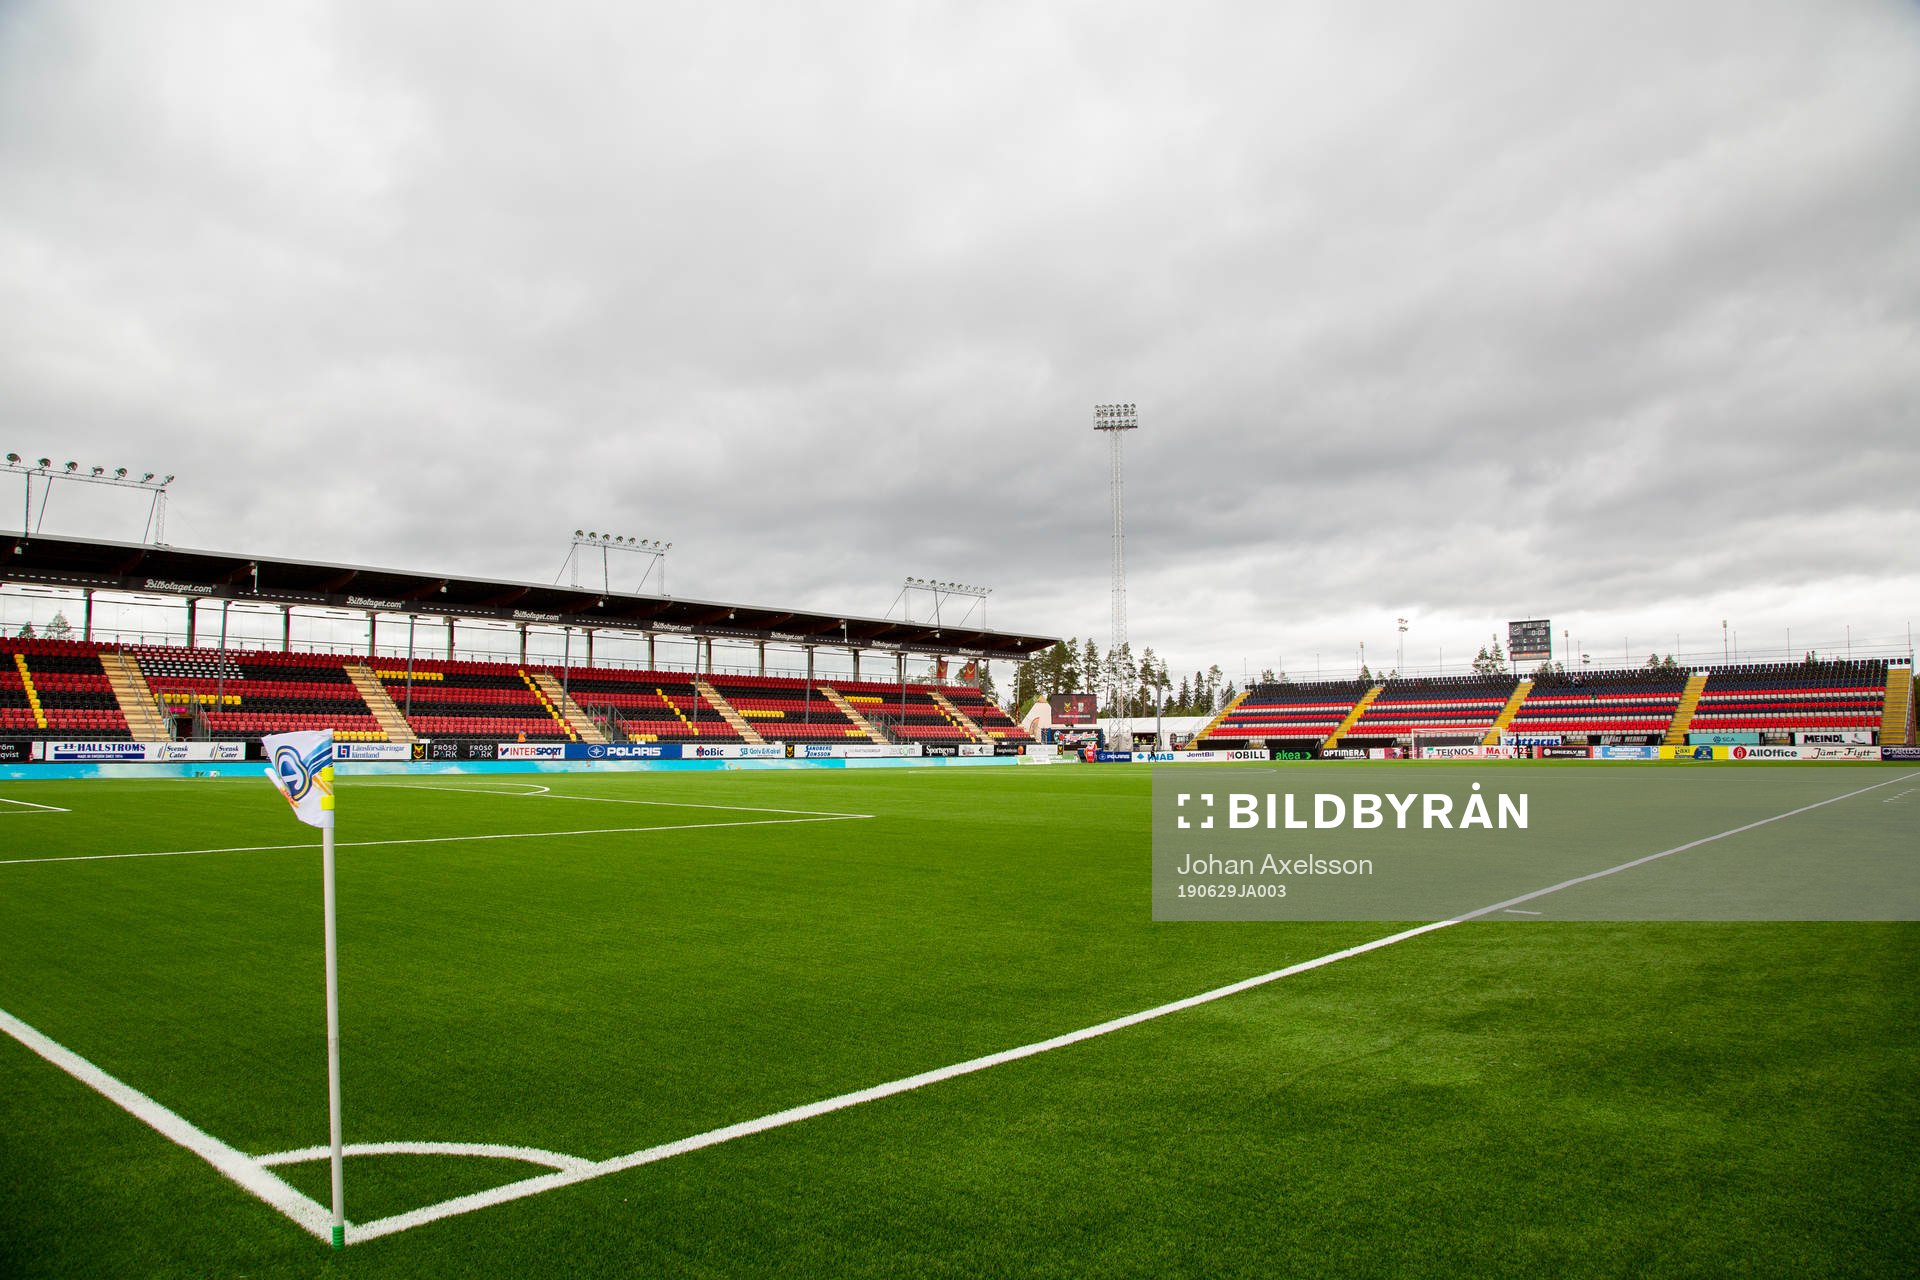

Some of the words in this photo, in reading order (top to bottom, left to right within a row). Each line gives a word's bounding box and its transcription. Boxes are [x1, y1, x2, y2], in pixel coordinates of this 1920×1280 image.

[144, 579, 212, 593] Bilbolaget.com
[346, 596, 402, 609] Bilbolaget.com
[513, 609, 560, 621] Bilbolaget.com
[1804, 735, 1845, 743] MEINDL
[510, 747, 562, 756] INTERSPORT
[607, 747, 662, 756] POLARIS
[1227, 750, 1265, 759] MOBILL
[1275, 750, 1301, 760] akea
[1436, 748, 1474, 756] TEKNOS
[1748, 749, 1797, 757] AllOffice
